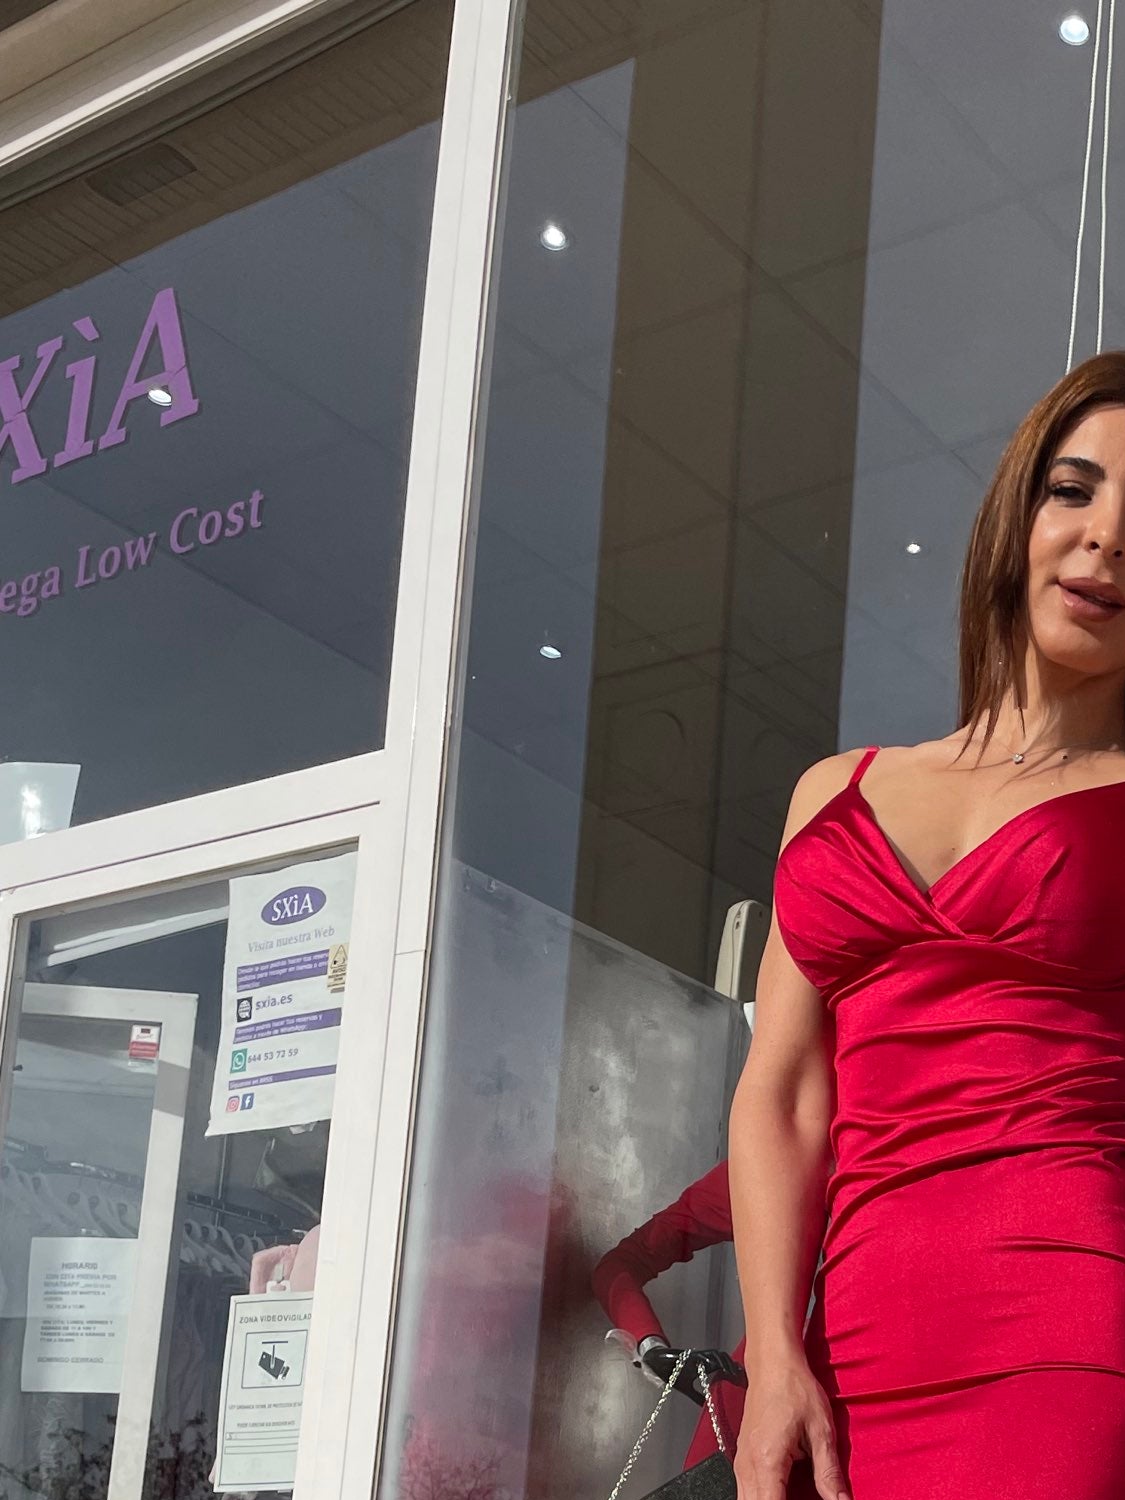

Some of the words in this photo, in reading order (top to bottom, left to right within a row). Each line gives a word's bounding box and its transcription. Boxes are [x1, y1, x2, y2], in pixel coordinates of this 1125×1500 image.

[75, 532, 157, 588] Low
[170, 490, 264, 554] Cost
[248, 940, 274, 953] Visita
[276, 932, 312, 948] nuestra
[314, 926, 335, 938] Web
[255, 994, 293, 1010] sxia.es
[264, 1052, 274, 1061] 53
[276, 1050, 286, 1059] 72
[288, 1048, 299, 1057] 59
[239, 1316, 258, 1324] ZONA
